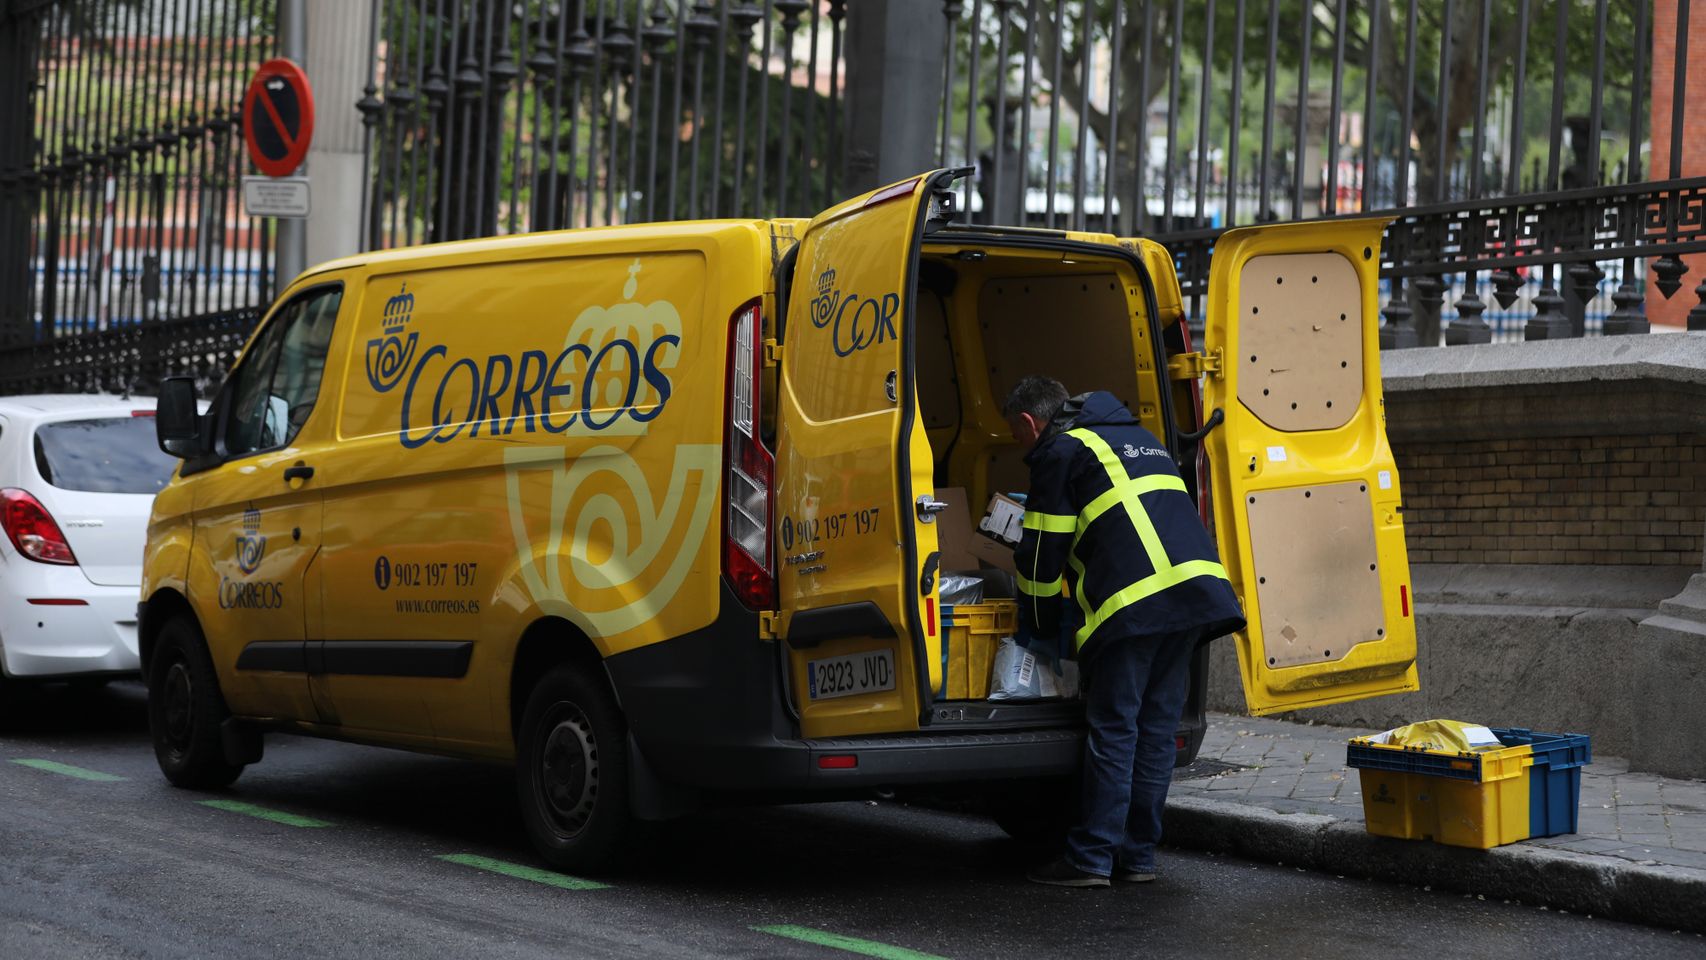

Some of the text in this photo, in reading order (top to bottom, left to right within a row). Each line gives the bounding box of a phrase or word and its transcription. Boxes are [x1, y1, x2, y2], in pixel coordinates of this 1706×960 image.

[400, 334, 680, 449] CORREOS
[797, 519, 820, 544] 902
[824, 514, 847, 539] 197
[854, 508, 879, 534] 197
[395, 564, 420, 587] 902
[425, 563, 448, 586] 197
[454, 562, 478, 586] 197
[219, 576, 283, 609] CORREOS
[395, 600, 480, 613] www.correos.es
[819, 655, 889, 694] 2923 JVD
